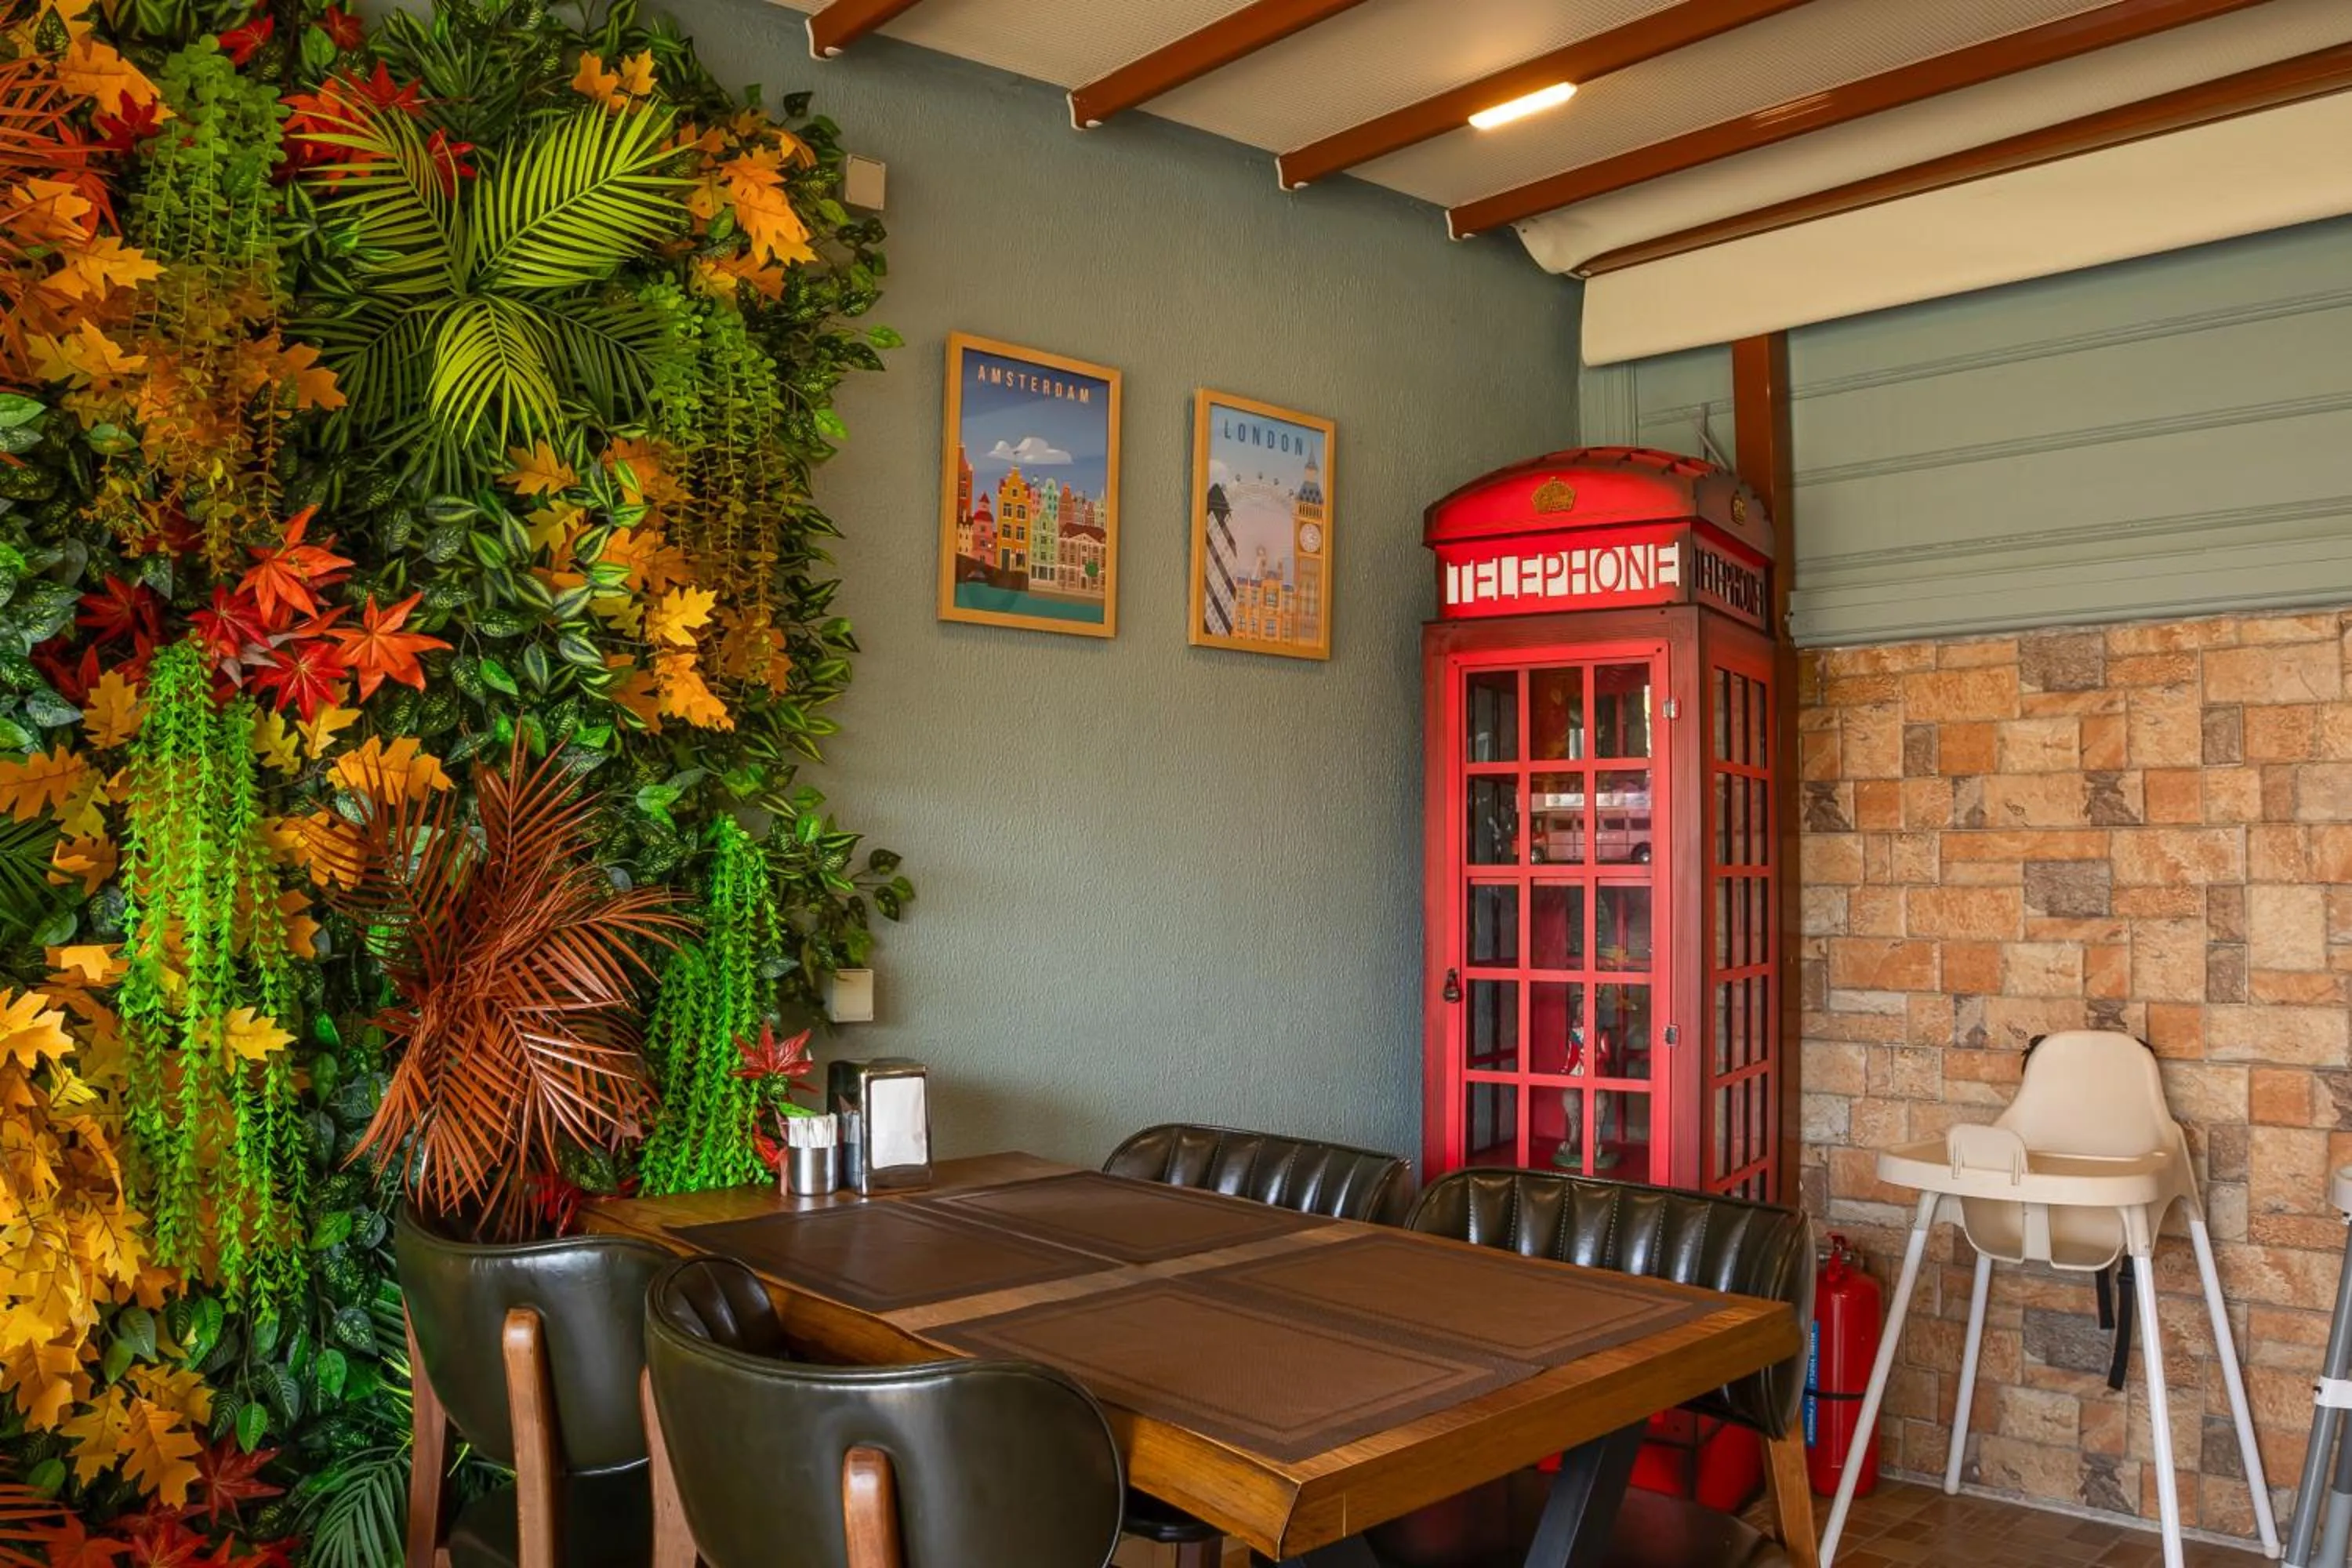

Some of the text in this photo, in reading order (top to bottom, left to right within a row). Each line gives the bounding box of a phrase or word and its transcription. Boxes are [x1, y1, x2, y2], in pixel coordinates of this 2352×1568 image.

[978, 364, 1090, 404] AMSTERDAM
[1224, 417, 1303, 456] LONDON
[1446, 542, 1679, 604] TELEPHONE
